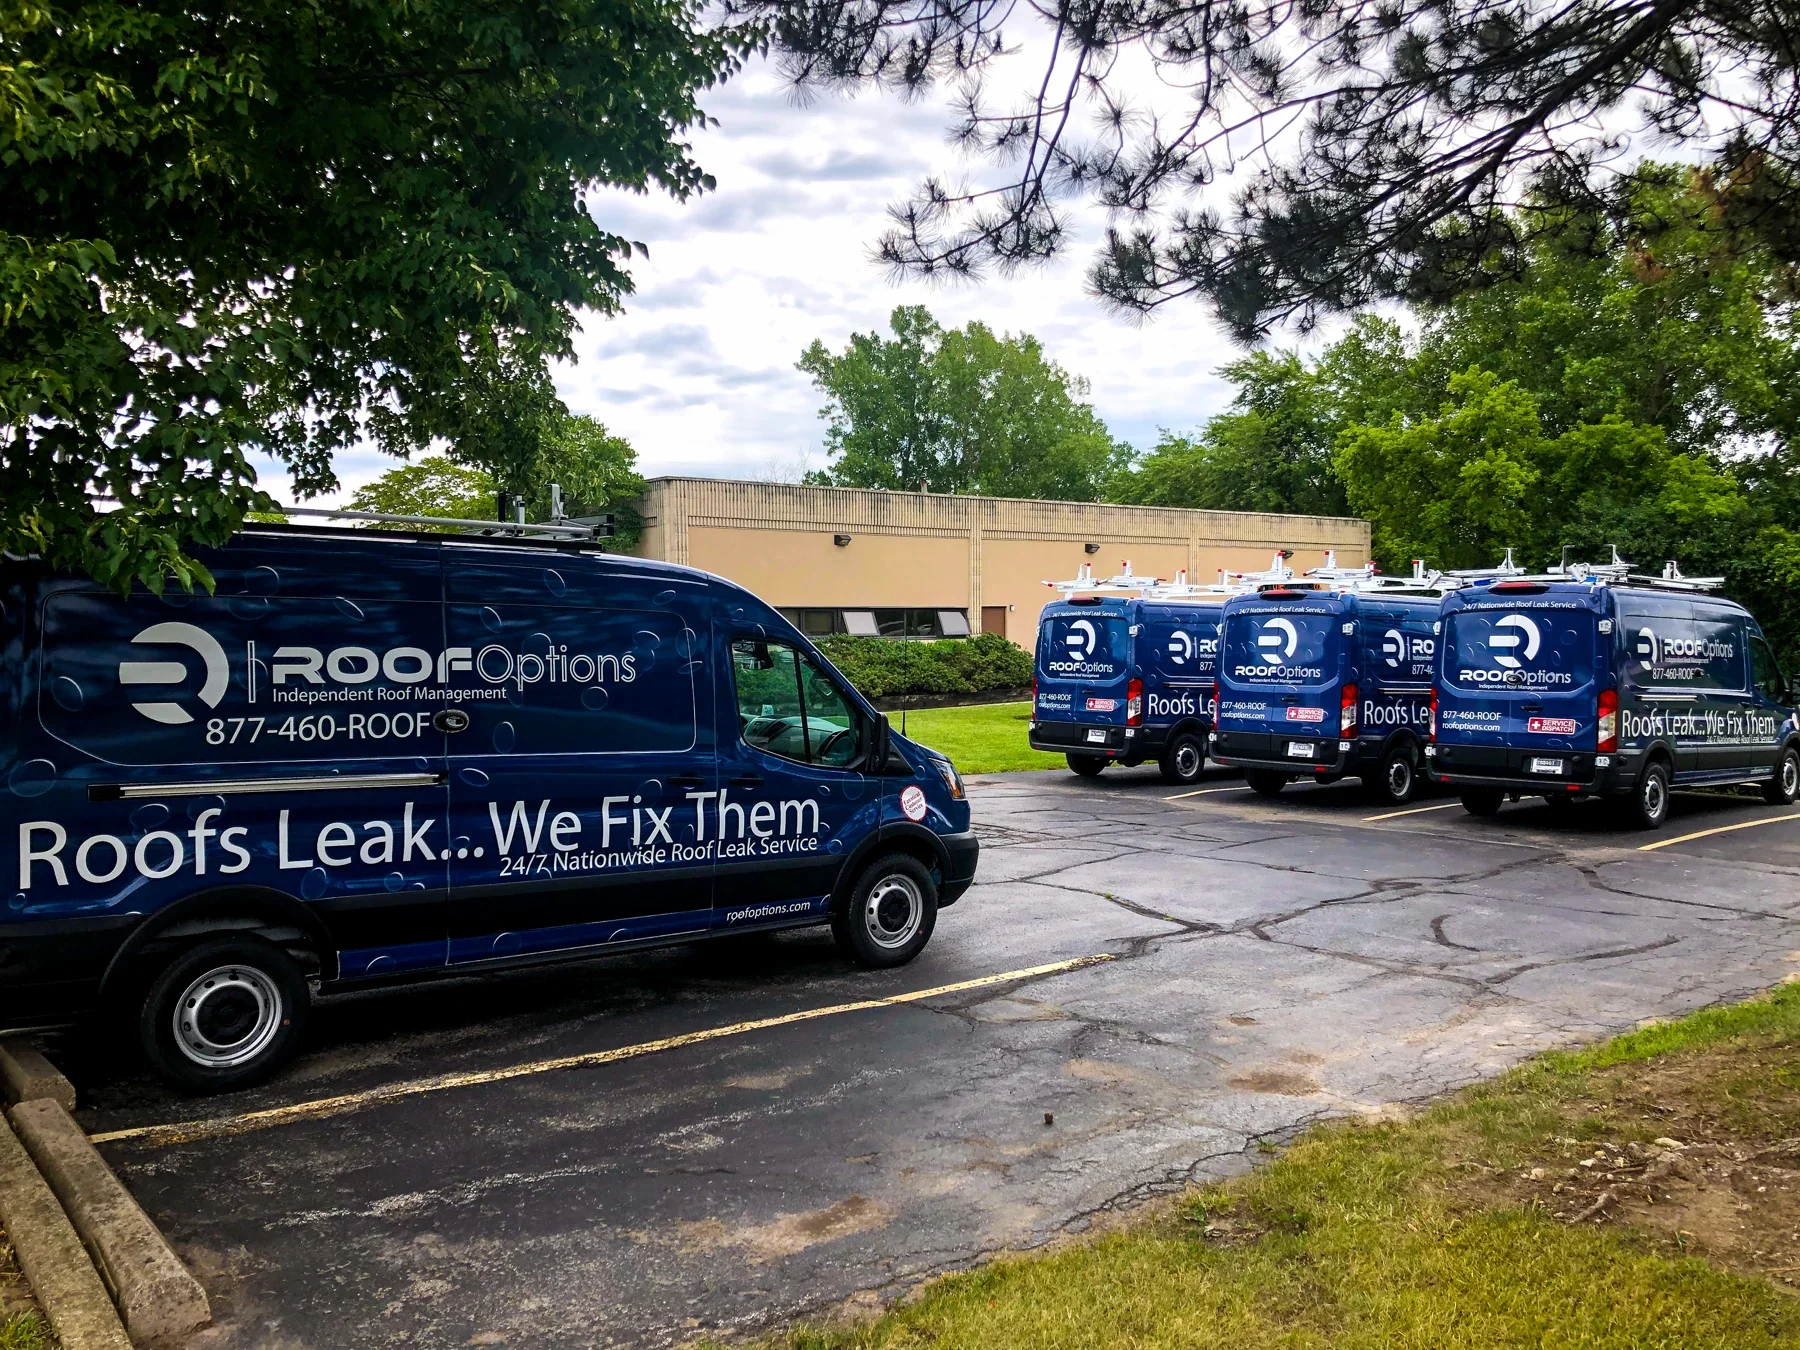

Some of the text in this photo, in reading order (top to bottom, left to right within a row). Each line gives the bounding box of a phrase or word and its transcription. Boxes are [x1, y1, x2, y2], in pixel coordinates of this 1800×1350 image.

[1478, 601, 1515, 609] Nationwide
[1516, 600, 1532, 608] Roof
[1664, 638, 1733, 660] ROOFOptions
[273, 644, 636, 691] ROOFOptions
[1049, 662, 1113, 673] ROOFOptions
[1235, 665, 1321, 679] ROOFOptions
[1652, 668, 1695, 680] 877-460-ROOF
[273, 686, 507, 705] Independent Roof Management
[1038, 693, 1072, 701] 877-460-ROOF
[1148, 692, 1195, 715] Roofs
[1221, 701, 1267, 710] 877-460-ROOF
[1364, 699, 1408, 724] Roofs
[1220, 711, 1265, 720] roofoptions.com
[1442, 710, 1502, 721] 877-460-ROOF
[1622, 708, 1663, 737] Roofs
[1727, 710, 1743, 735] Fix
[1745, 710, 1775, 735] Them
[206, 712, 430, 745] 877-460-ROOF
[1442, 721, 1500, 731] roofoptions.com
[1717, 735, 1740, 744] Nationwide
[19, 808, 251, 890] Roofs
[601, 795, 674, 848] Fix
[685, 788, 819, 841] Them
[499, 835, 817, 877] 24/7 Nationwide Roof Leak Service
[726, 901, 811, 923] roofoptions.com
